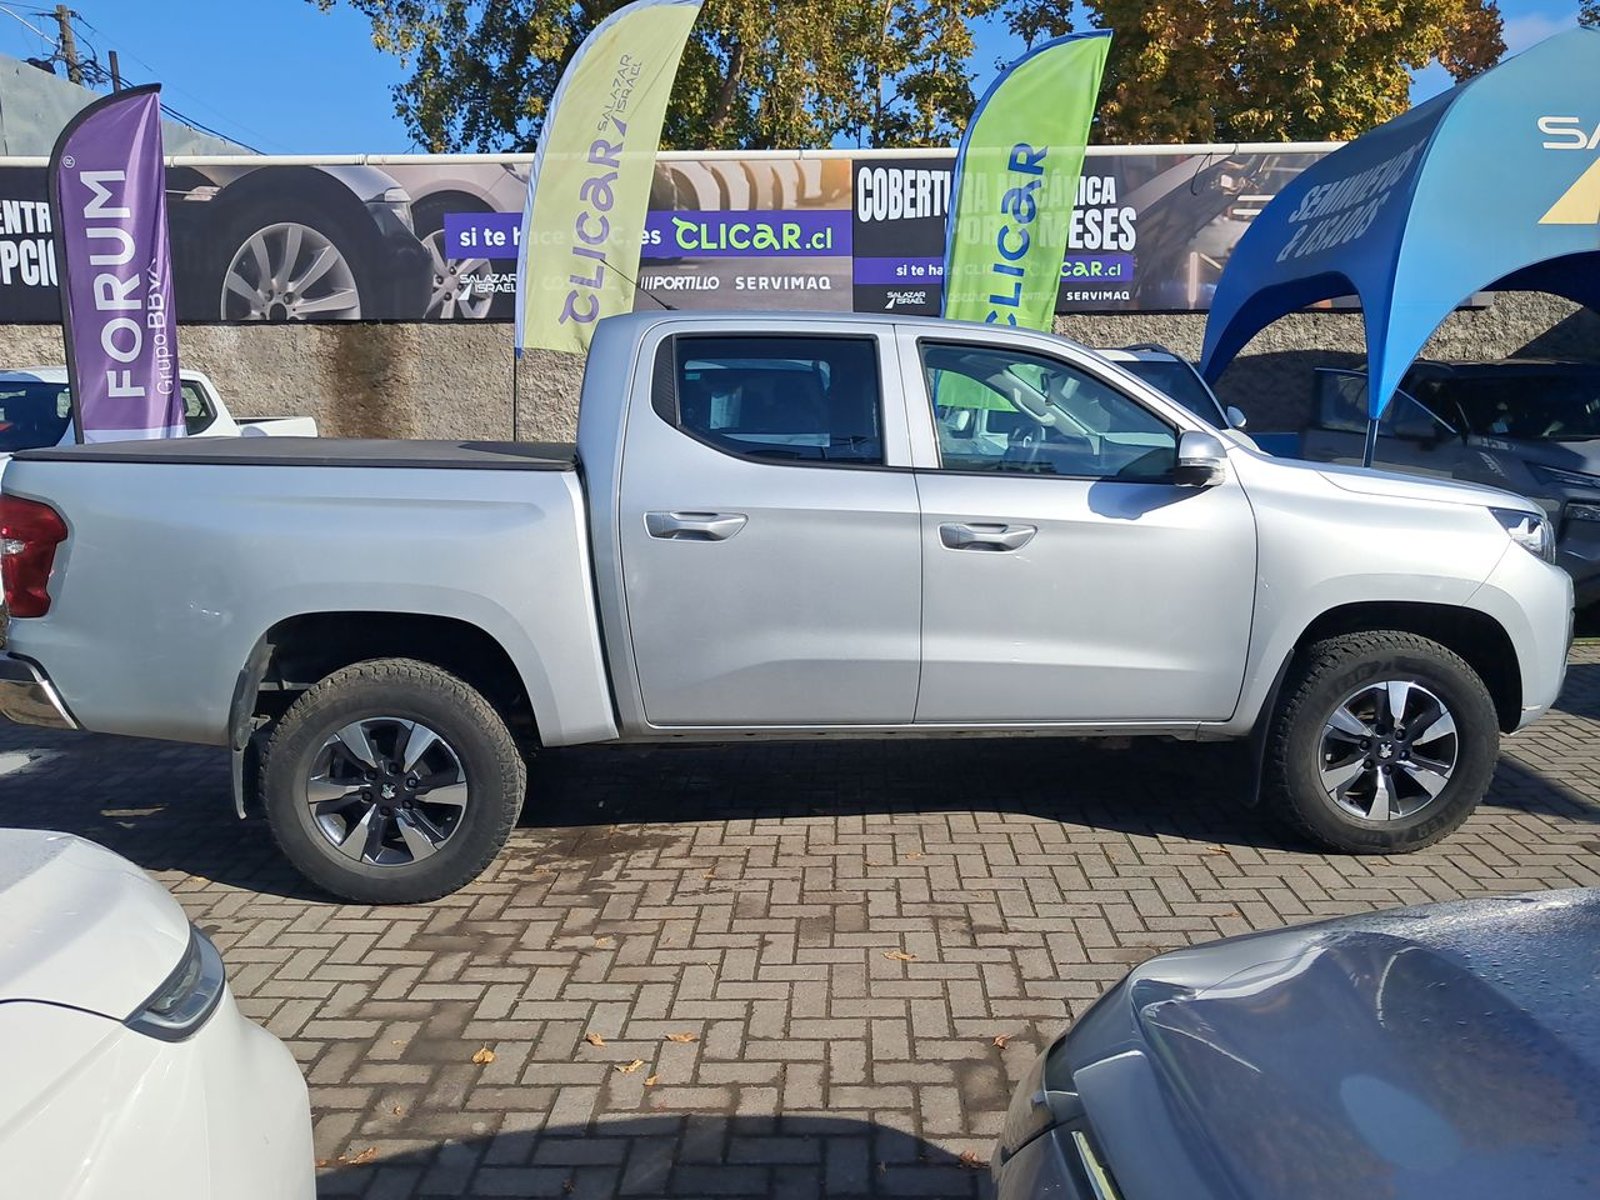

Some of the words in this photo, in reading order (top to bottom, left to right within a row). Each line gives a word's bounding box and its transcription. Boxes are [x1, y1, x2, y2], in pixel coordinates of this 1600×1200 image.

[597, 54, 633, 132] SALAZAR
[614, 62, 642, 113] ISRAEL
[460, 226, 477, 246] si
[483, 228, 506, 246] te
[896, 264, 907, 276] si
[911, 264, 925, 276] te
[80, 169, 145, 398] FORUM
[735, 276, 832, 290] SERVIMAQ
[886, 291, 926, 299] SALAZAR
[1066, 291, 1131, 301] SERVIMAQ
[156, 334, 174, 395] Grupo
